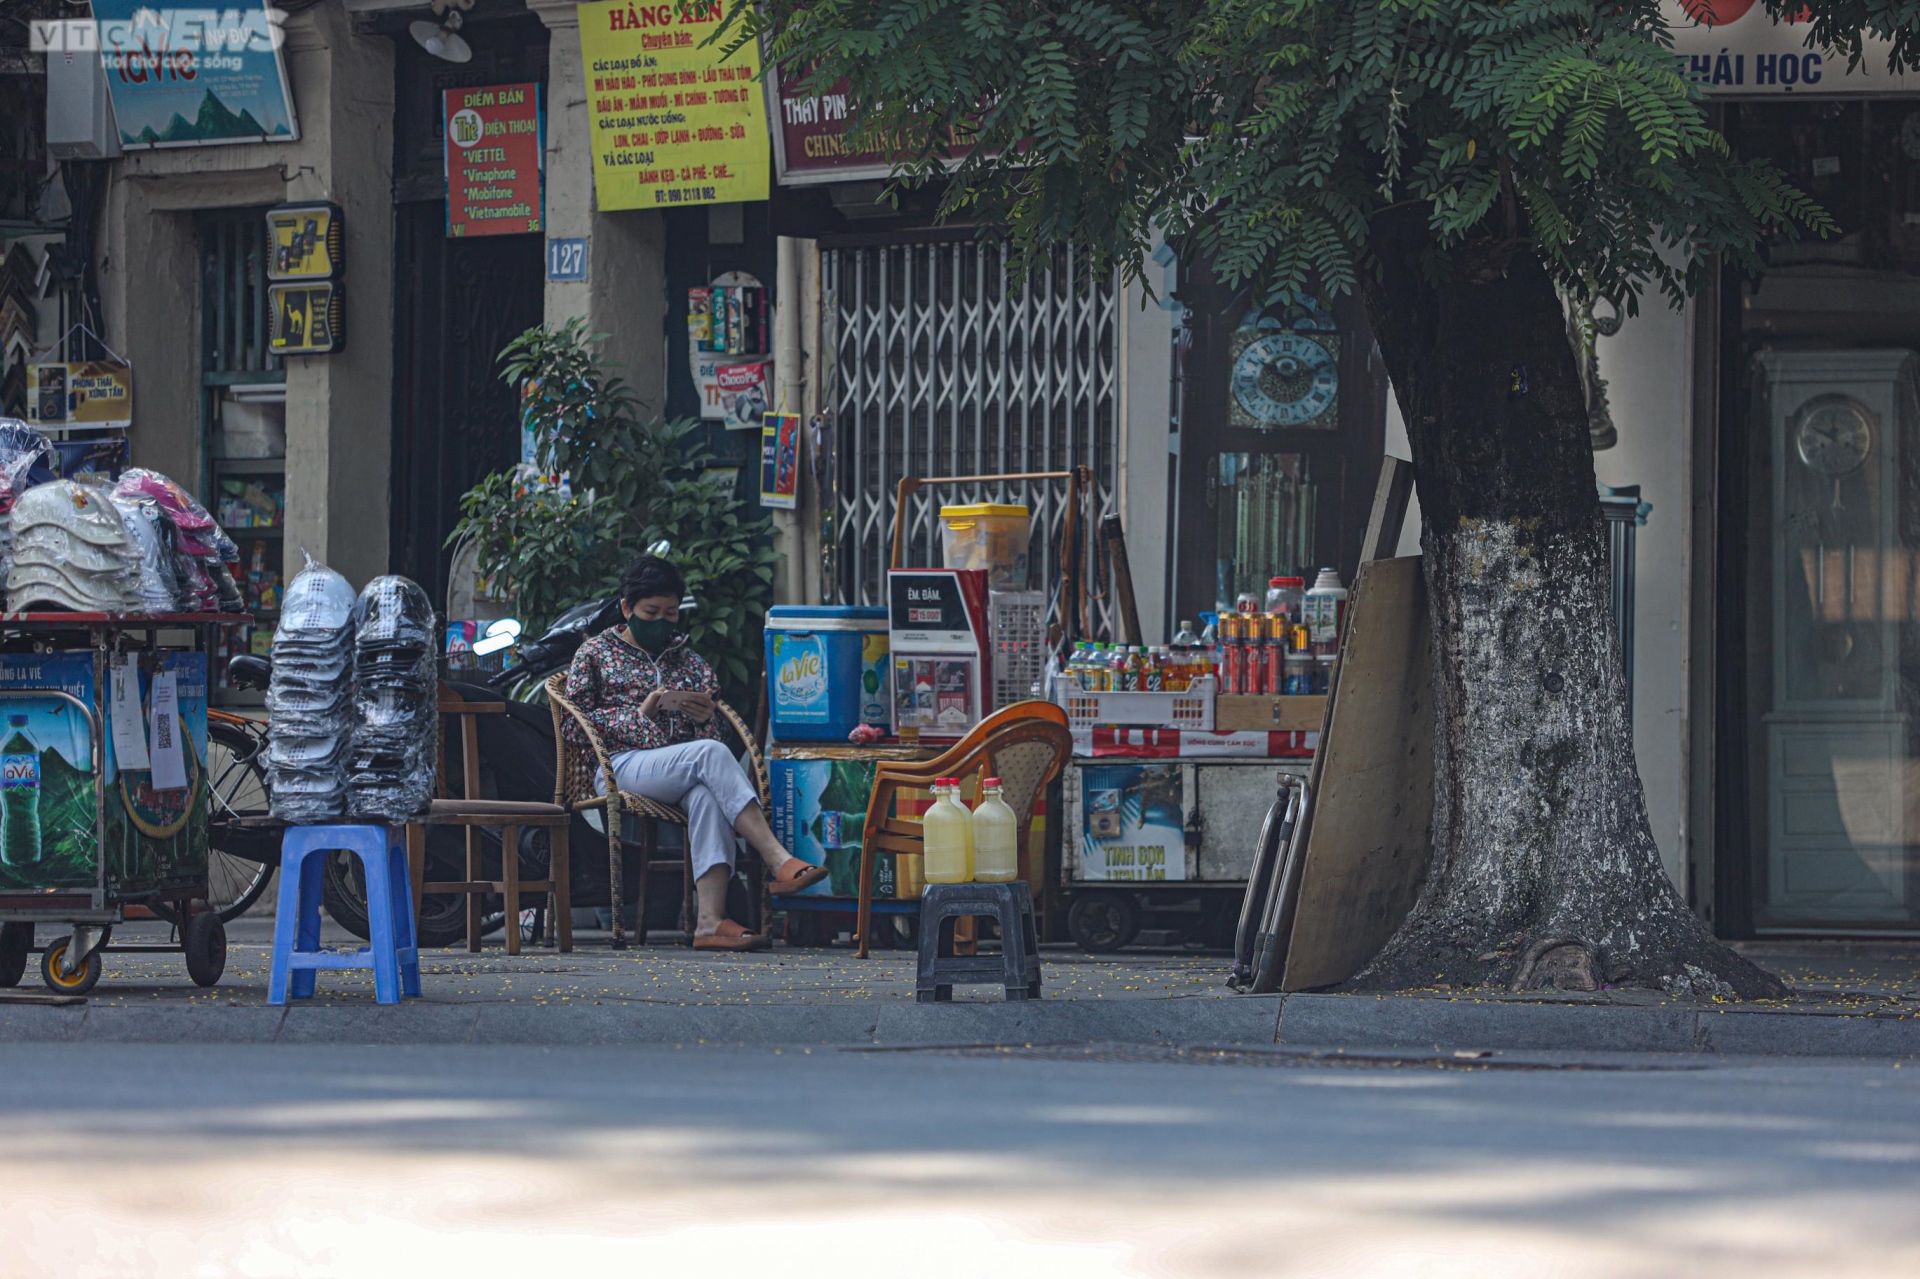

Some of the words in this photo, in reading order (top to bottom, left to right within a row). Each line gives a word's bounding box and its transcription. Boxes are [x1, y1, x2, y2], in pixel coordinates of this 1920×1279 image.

[608, 2, 672, 31] HÀNG
[641, 32, 673, 48] Chuyên
[593, 59, 609, 71] CÁC
[610, 59, 629, 71] LOẠI
[1756, 53, 1822, 91] HỌC
[499, 87, 525, 105] BÁN
[783, 94, 819, 125] THAY
[823, 94, 847, 121] PIN
[455, 114, 479, 142] Thẻ
[484, 117, 507, 138] ĐIỆN
[508, 118, 536, 137] THOẠI
[598, 116, 615, 129] CÁC
[617, 117, 635, 129] LOẠI
[636, 113, 659, 126] NƯỚC
[467, 147, 506, 164] VIETTEL
[603, 150, 616, 166] VÀ
[617, 149, 633, 165] CÁC
[634, 151, 654, 166] LOẠI
[468, 168, 517, 184] Vinaphone
[468, 187, 513, 201] Mobifone
[469, 202, 531, 219] Vietnamobile
[551, 243, 583, 274] 127
[72, 378, 95, 388] PHONG
[17, 667, 27, 680] LA
[29, 667, 42, 680] VIE
[783, 650, 819, 684] laVie
[1146, 676, 1162, 690] C2
[3, 765, 35, 779] laVie
[1103, 846, 1134, 866] TINH
